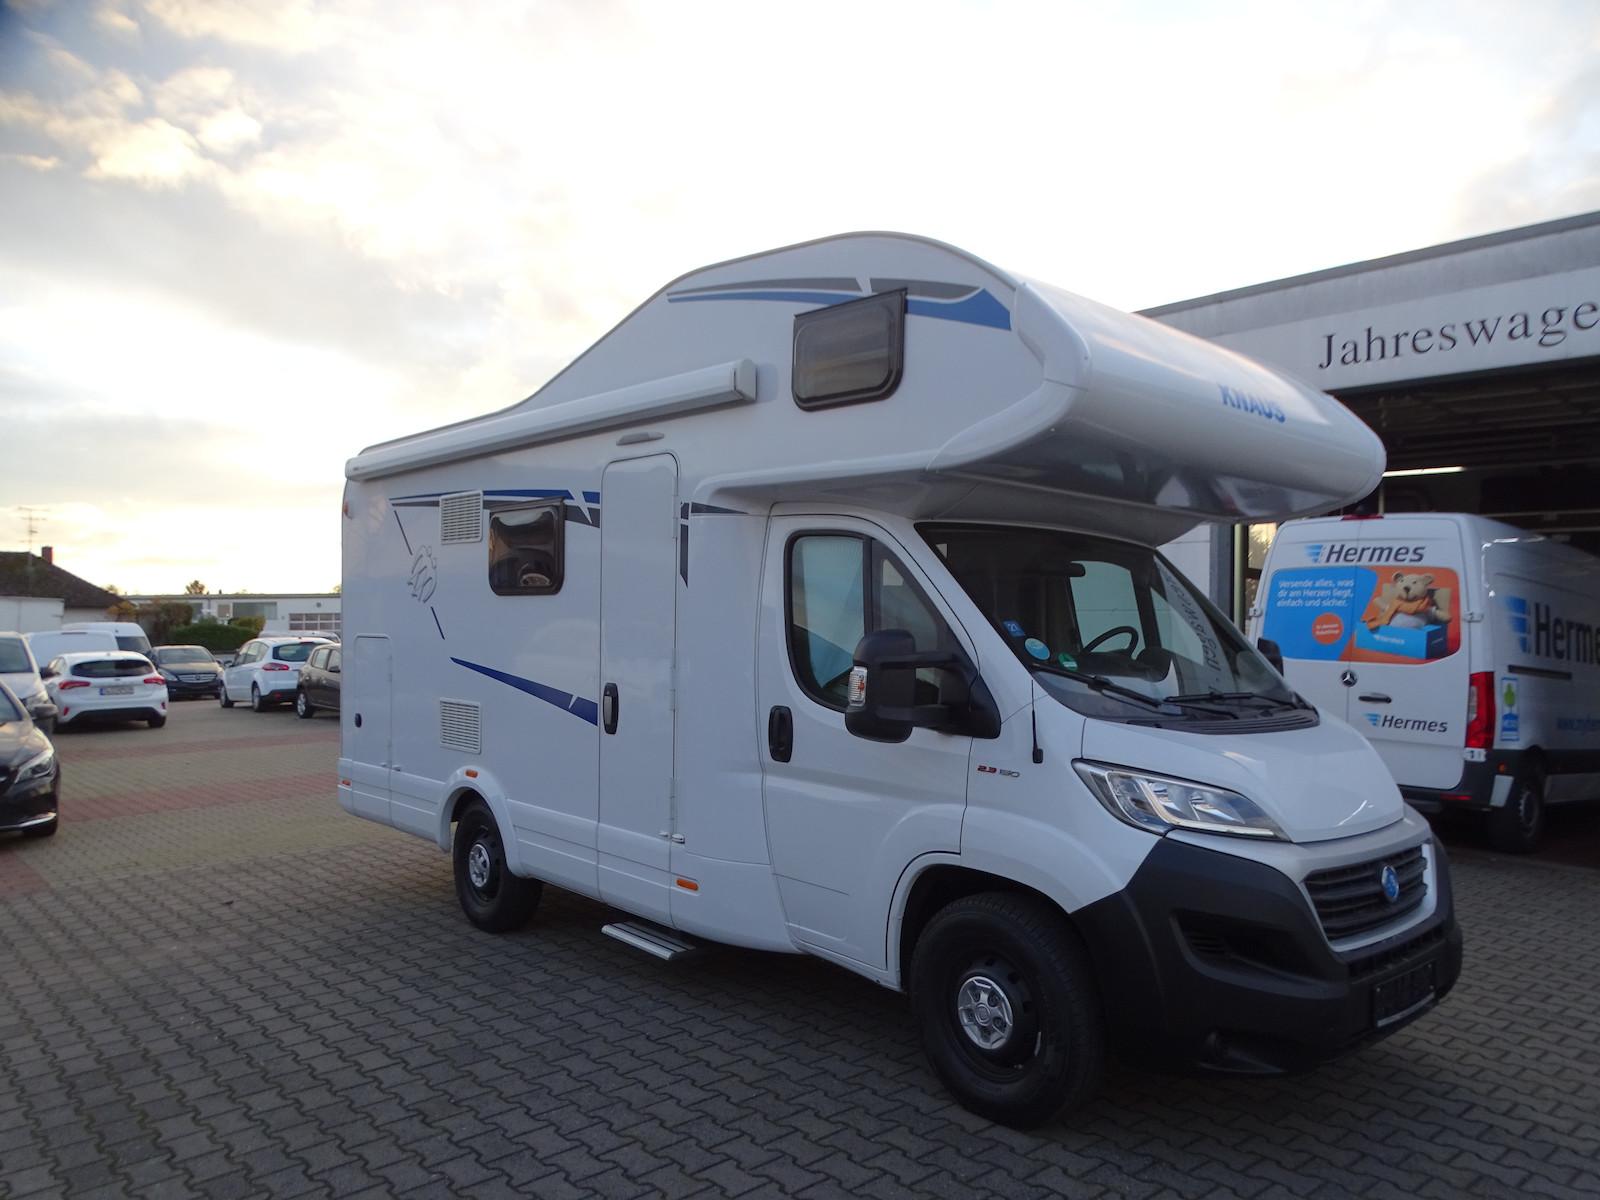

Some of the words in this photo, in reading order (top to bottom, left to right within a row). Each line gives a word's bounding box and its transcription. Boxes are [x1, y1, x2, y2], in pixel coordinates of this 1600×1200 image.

[1318, 299, 1600, 369] Jahreswage
[1218, 384, 1286, 424] KNAUS
[1325, 544, 1426, 563] Hermes
[1381, 715, 1448, 732] Hermes
